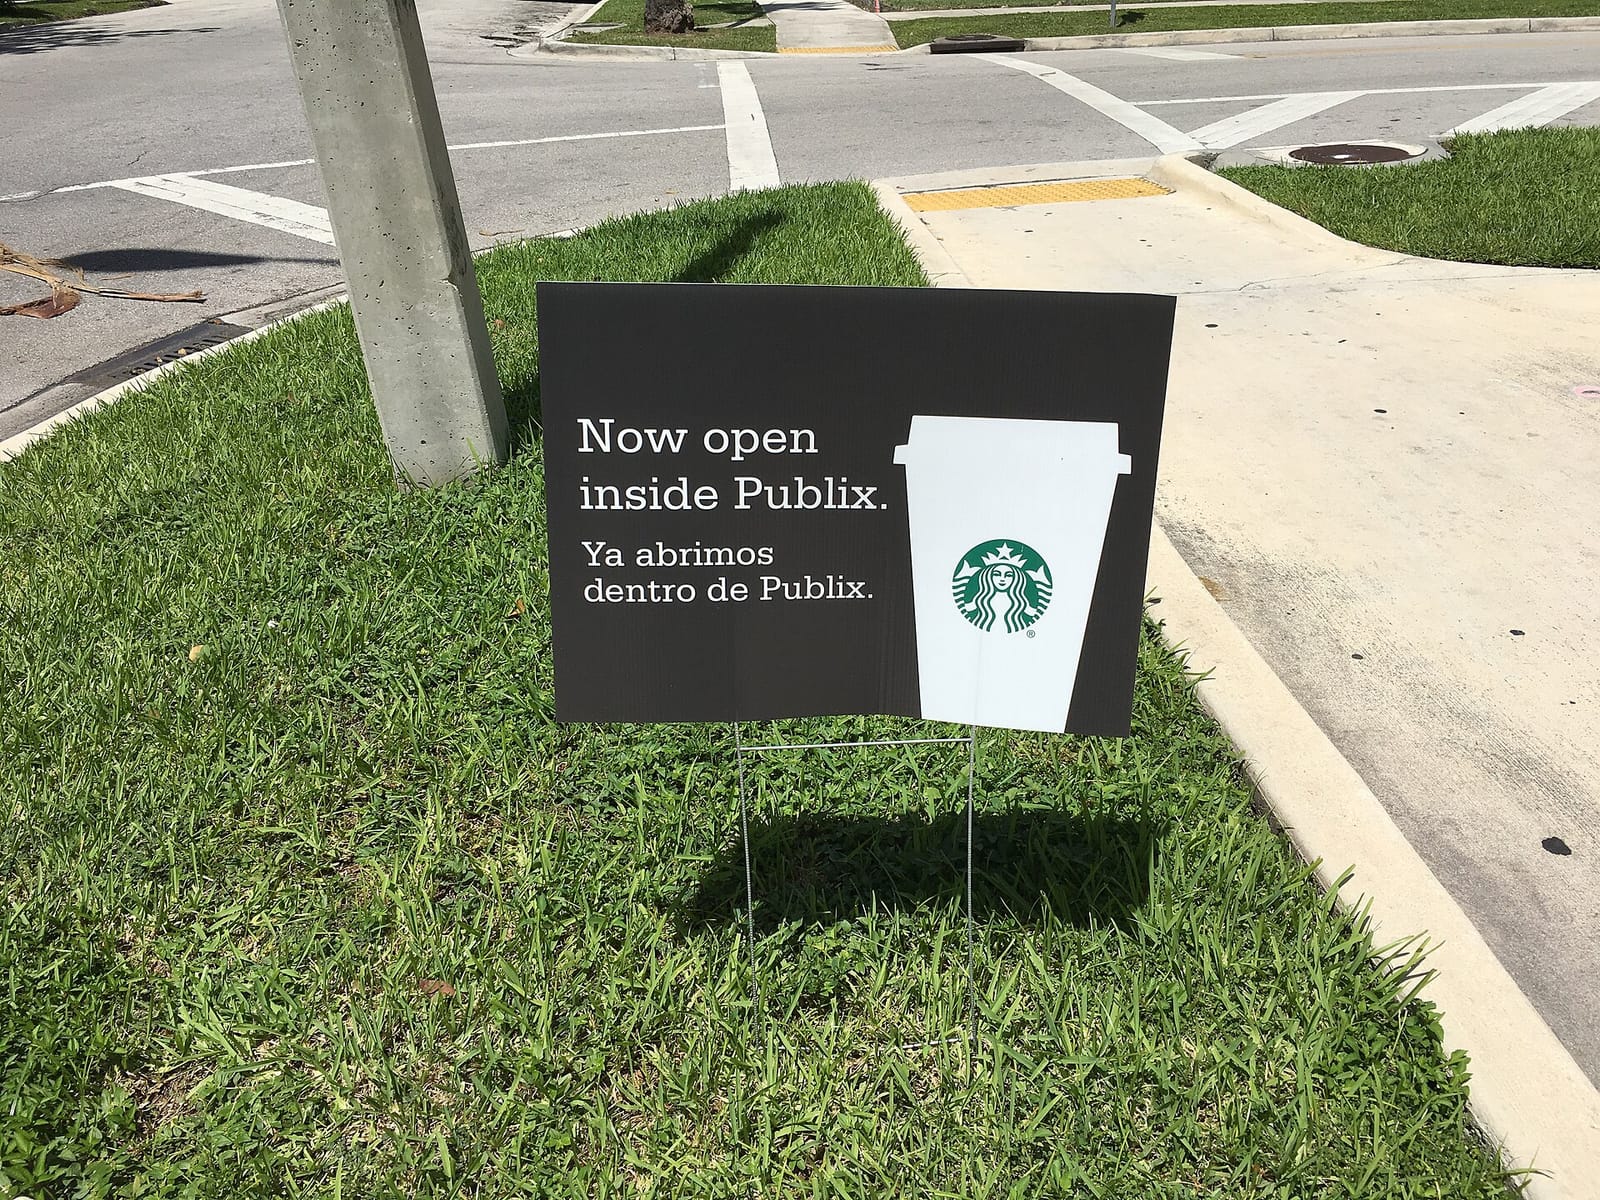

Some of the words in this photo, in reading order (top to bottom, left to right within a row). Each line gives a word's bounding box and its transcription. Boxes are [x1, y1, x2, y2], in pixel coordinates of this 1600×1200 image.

[576, 418, 689, 454] Now
[703, 428, 819, 461] open
[579, 476, 719, 511] inside
[733, 476, 888, 510] Publix.
[581, 541, 625, 567] Ya
[635, 541, 774, 567] abrimos
[583, 577, 696, 603] dentro
[707, 576, 749, 602] de
[759, 574, 873, 601] Publix.
